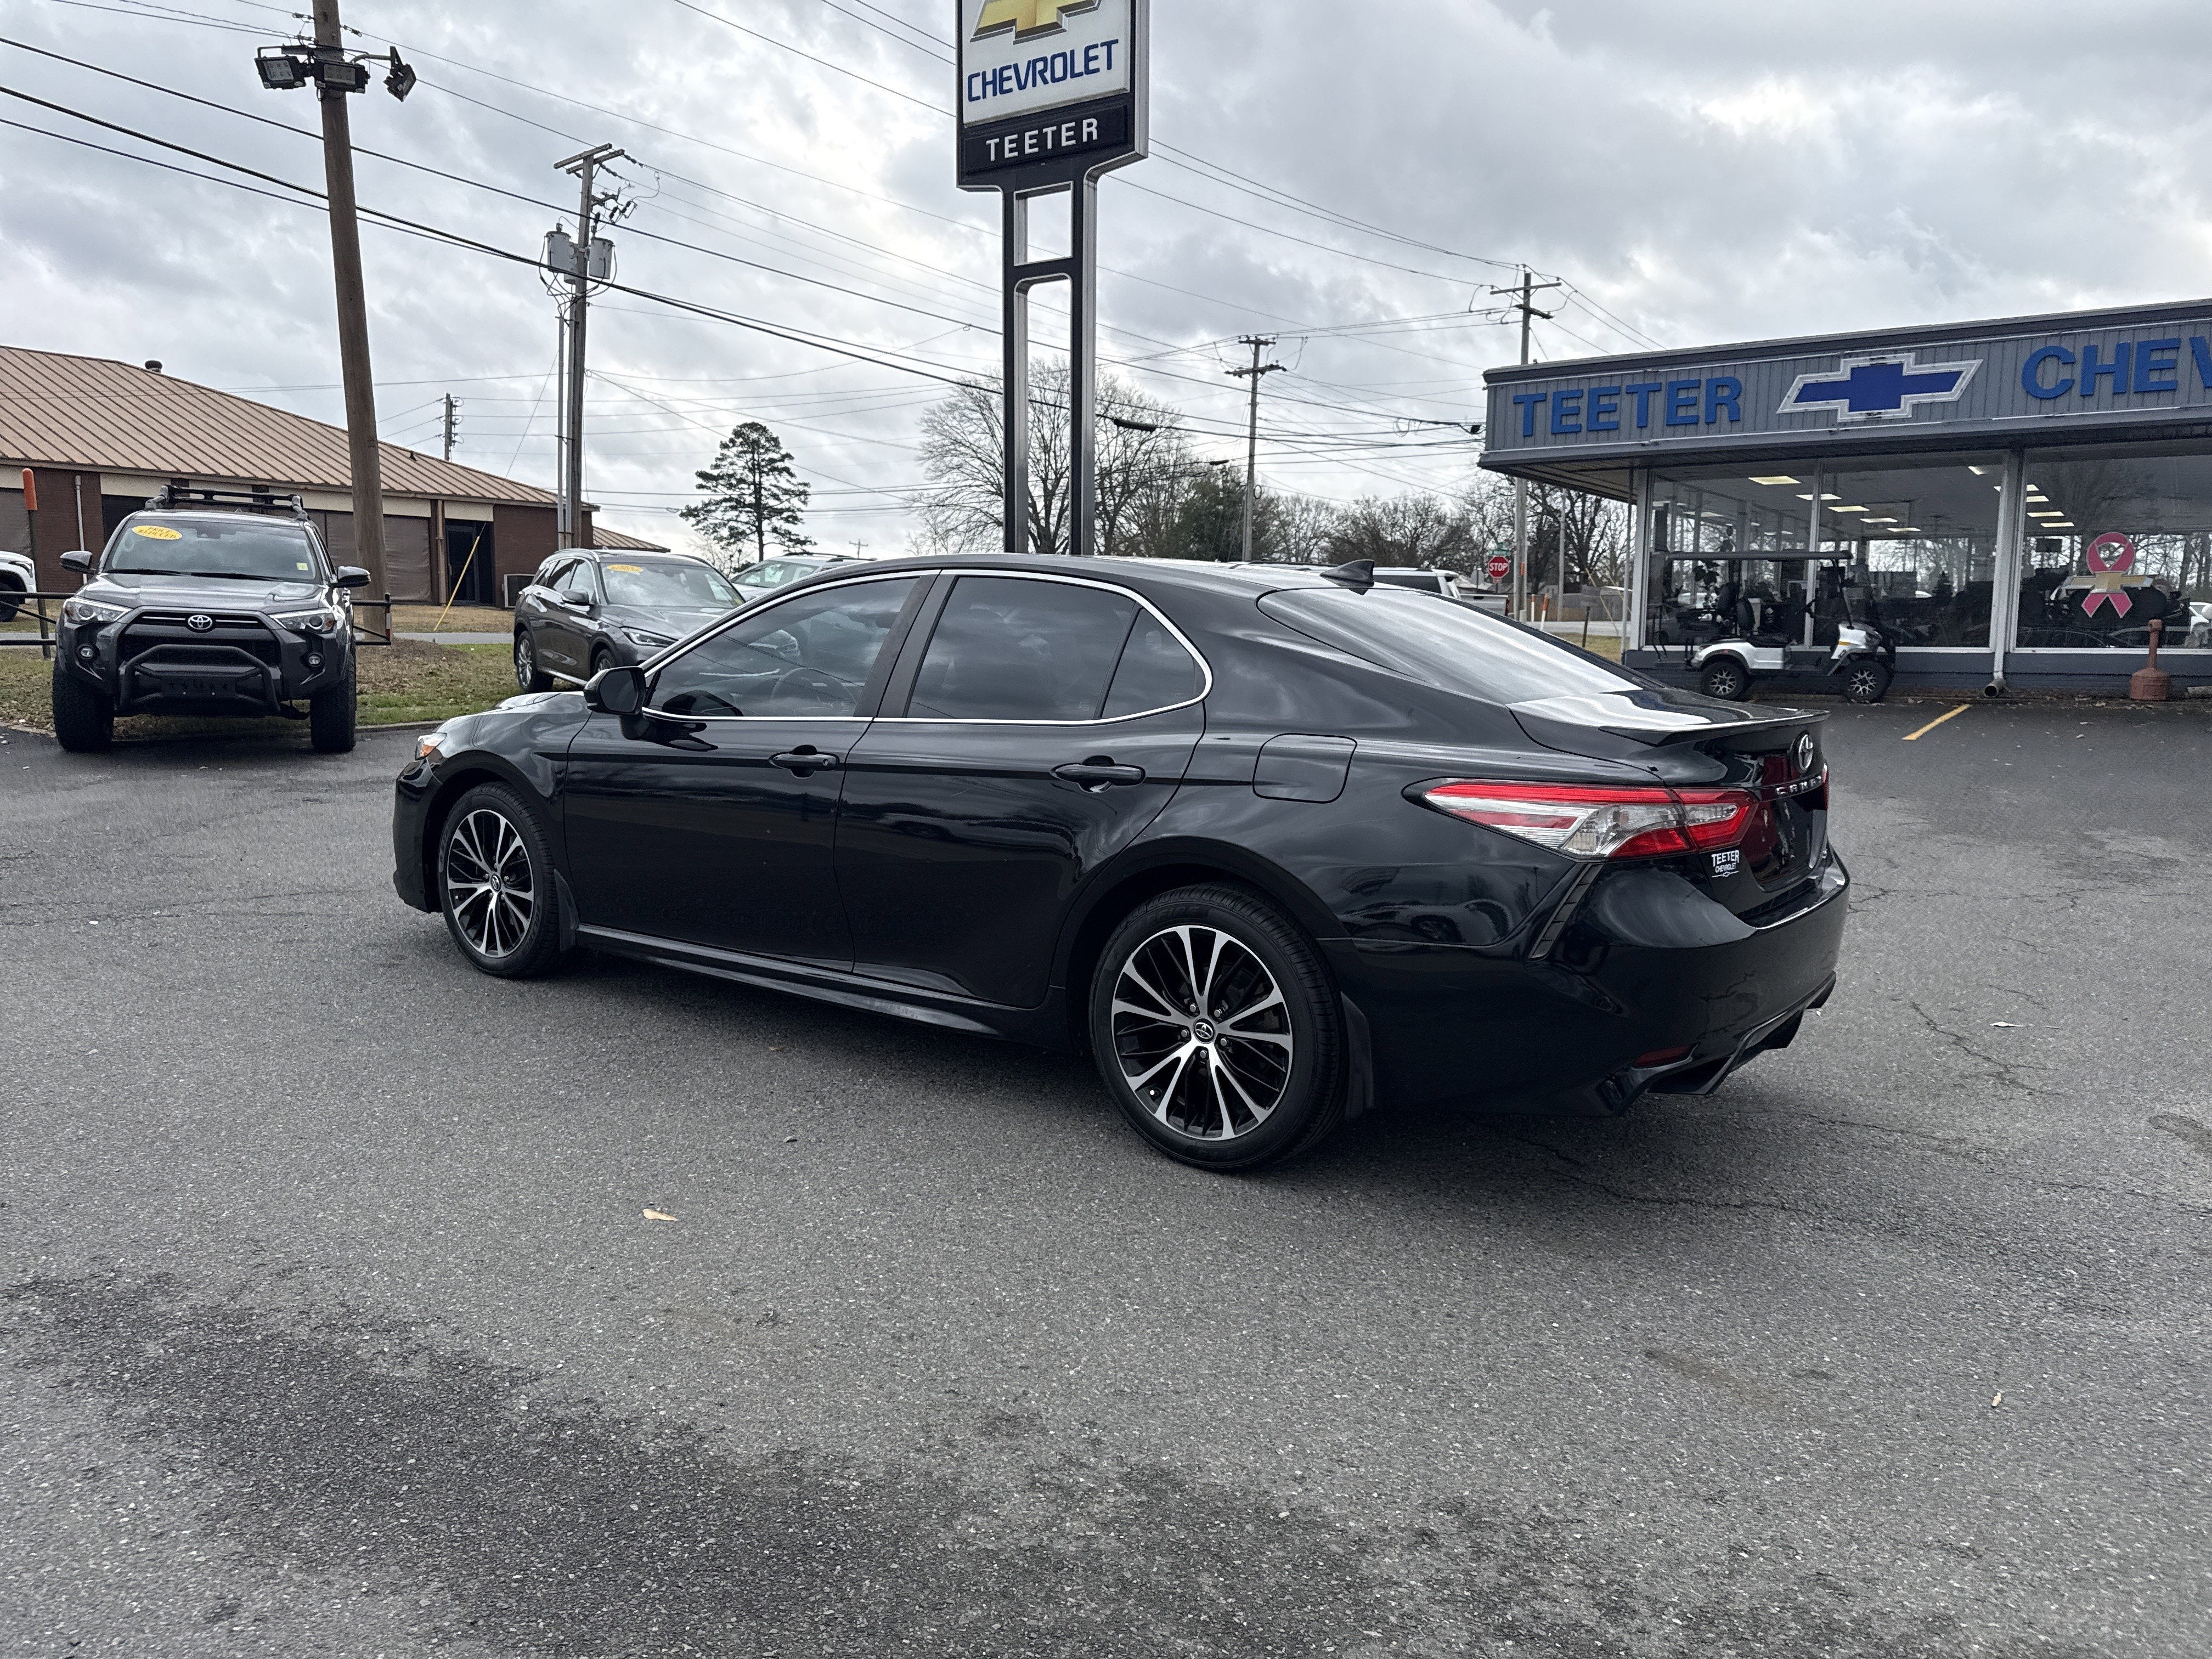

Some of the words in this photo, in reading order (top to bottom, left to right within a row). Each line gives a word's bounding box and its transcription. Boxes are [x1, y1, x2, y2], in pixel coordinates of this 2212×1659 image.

[967, 39, 1119, 102] CHEVROLET
[986, 118, 1098, 162] TEETER
[1513, 376, 1742, 437] TEETER
[1489, 562, 1508, 571] STOP
[1711, 850, 1740, 867] TEETER
